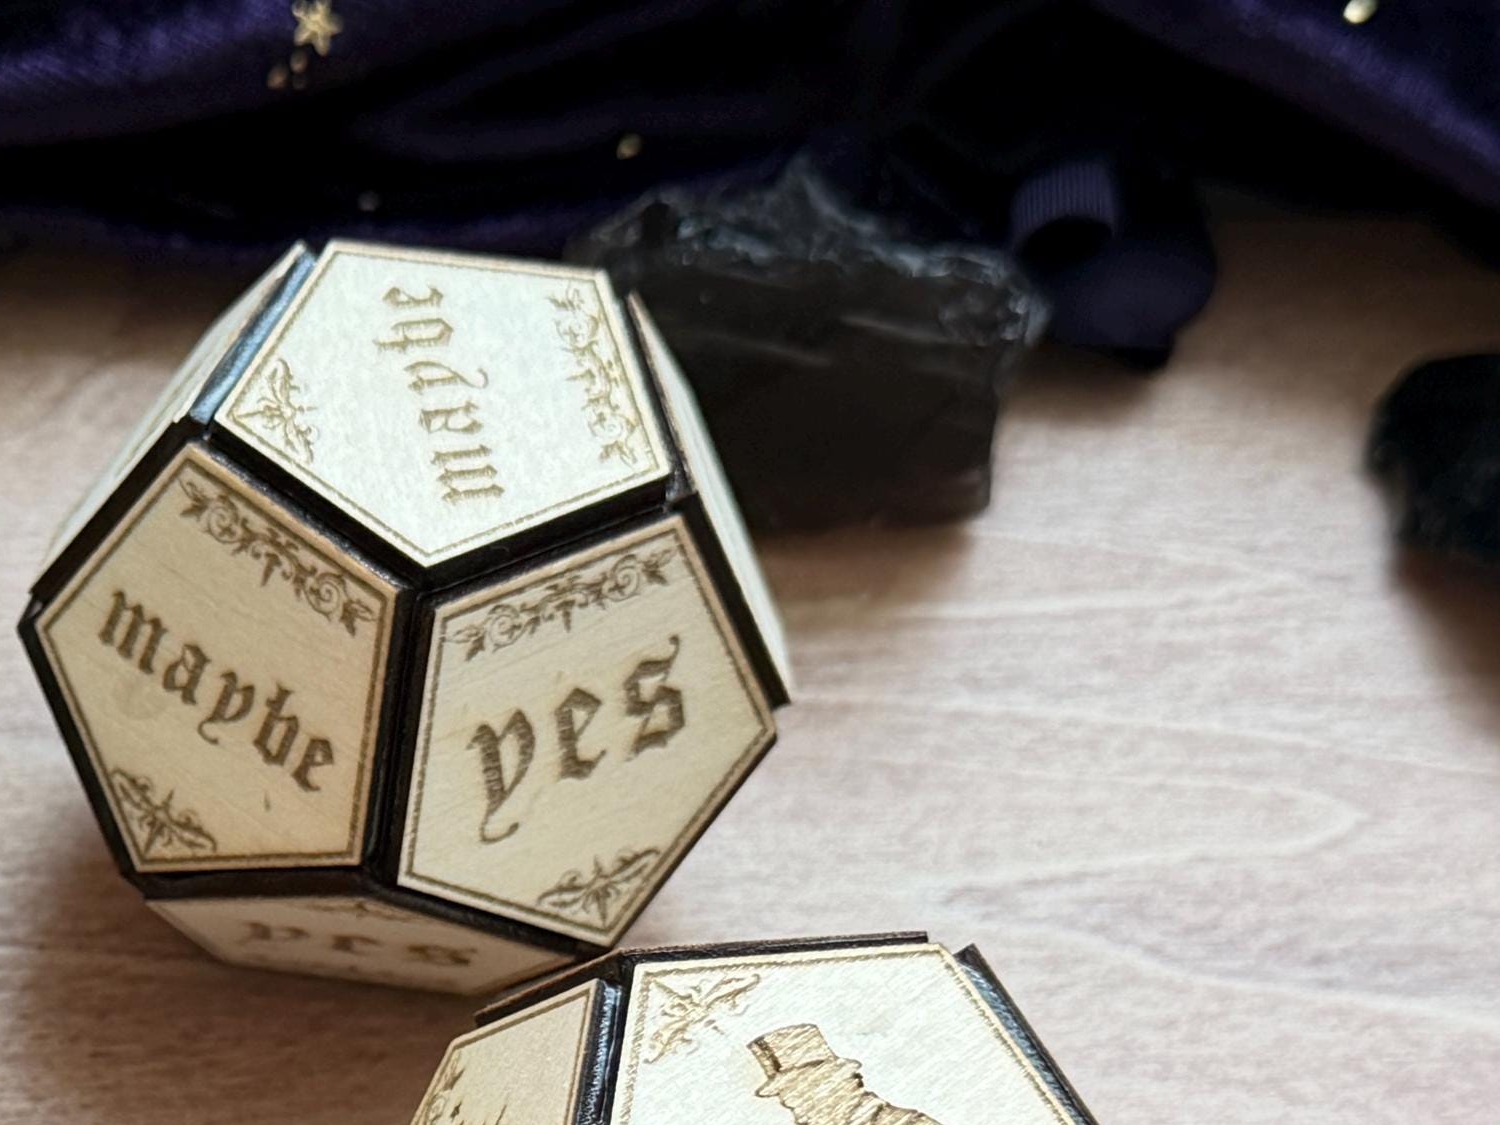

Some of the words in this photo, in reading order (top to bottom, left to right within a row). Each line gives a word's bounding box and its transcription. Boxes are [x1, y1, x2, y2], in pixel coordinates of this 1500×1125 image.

[373, 284, 505, 506] maybe
[98, 588, 336, 792] maybe
[467, 635, 687, 843] yes
